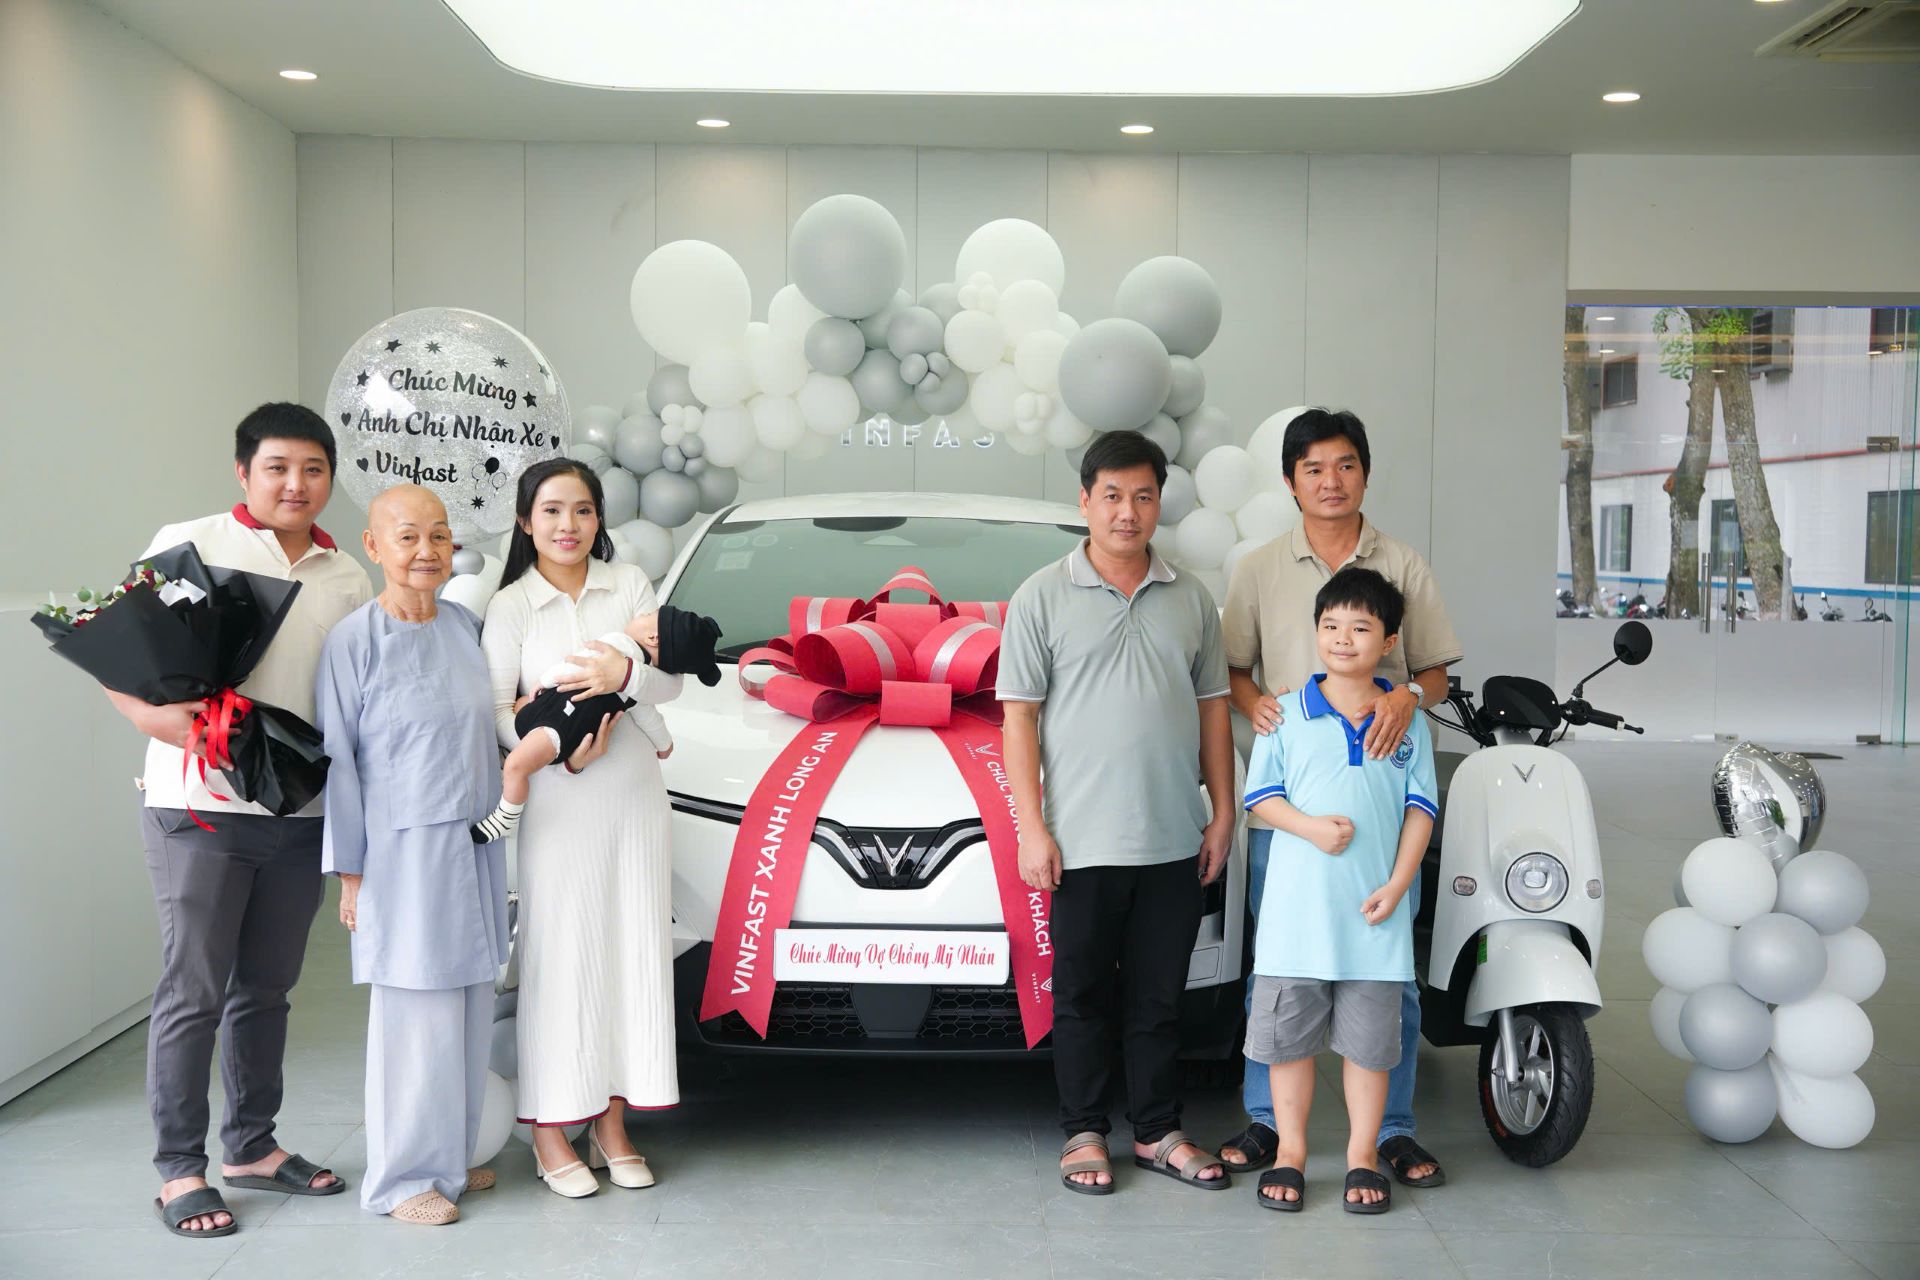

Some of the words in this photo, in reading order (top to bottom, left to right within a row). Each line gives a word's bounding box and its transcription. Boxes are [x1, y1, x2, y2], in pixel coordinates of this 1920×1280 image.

[388, 368, 448, 393] Chúc
[453, 371, 517, 410] Mừng
[357, 408, 401, 434] Anh
[405, 410, 448, 443] Chị
[453, 415, 517, 449] Nhận
[520, 422, 545, 447] Xe
[376, 450, 458, 485] Vinfast
[731, 884, 770, 995] VINFAST
[755, 805, 792, 880] XANH
[778, 756, 821, 801] LONG
[811, 731, 838, 753] AN
[1028, 891, 1051, 957] KHÁCH
[790, 942, 822, 964] Chúc
[823, 943, 862, 968] Mừng
[865, 943, 886, 970] Vợ
[889, 942, 930, 969] Chồng
[931, 943, 954, 969] Mỹ
[957, 943, 996, 965] Nhân
